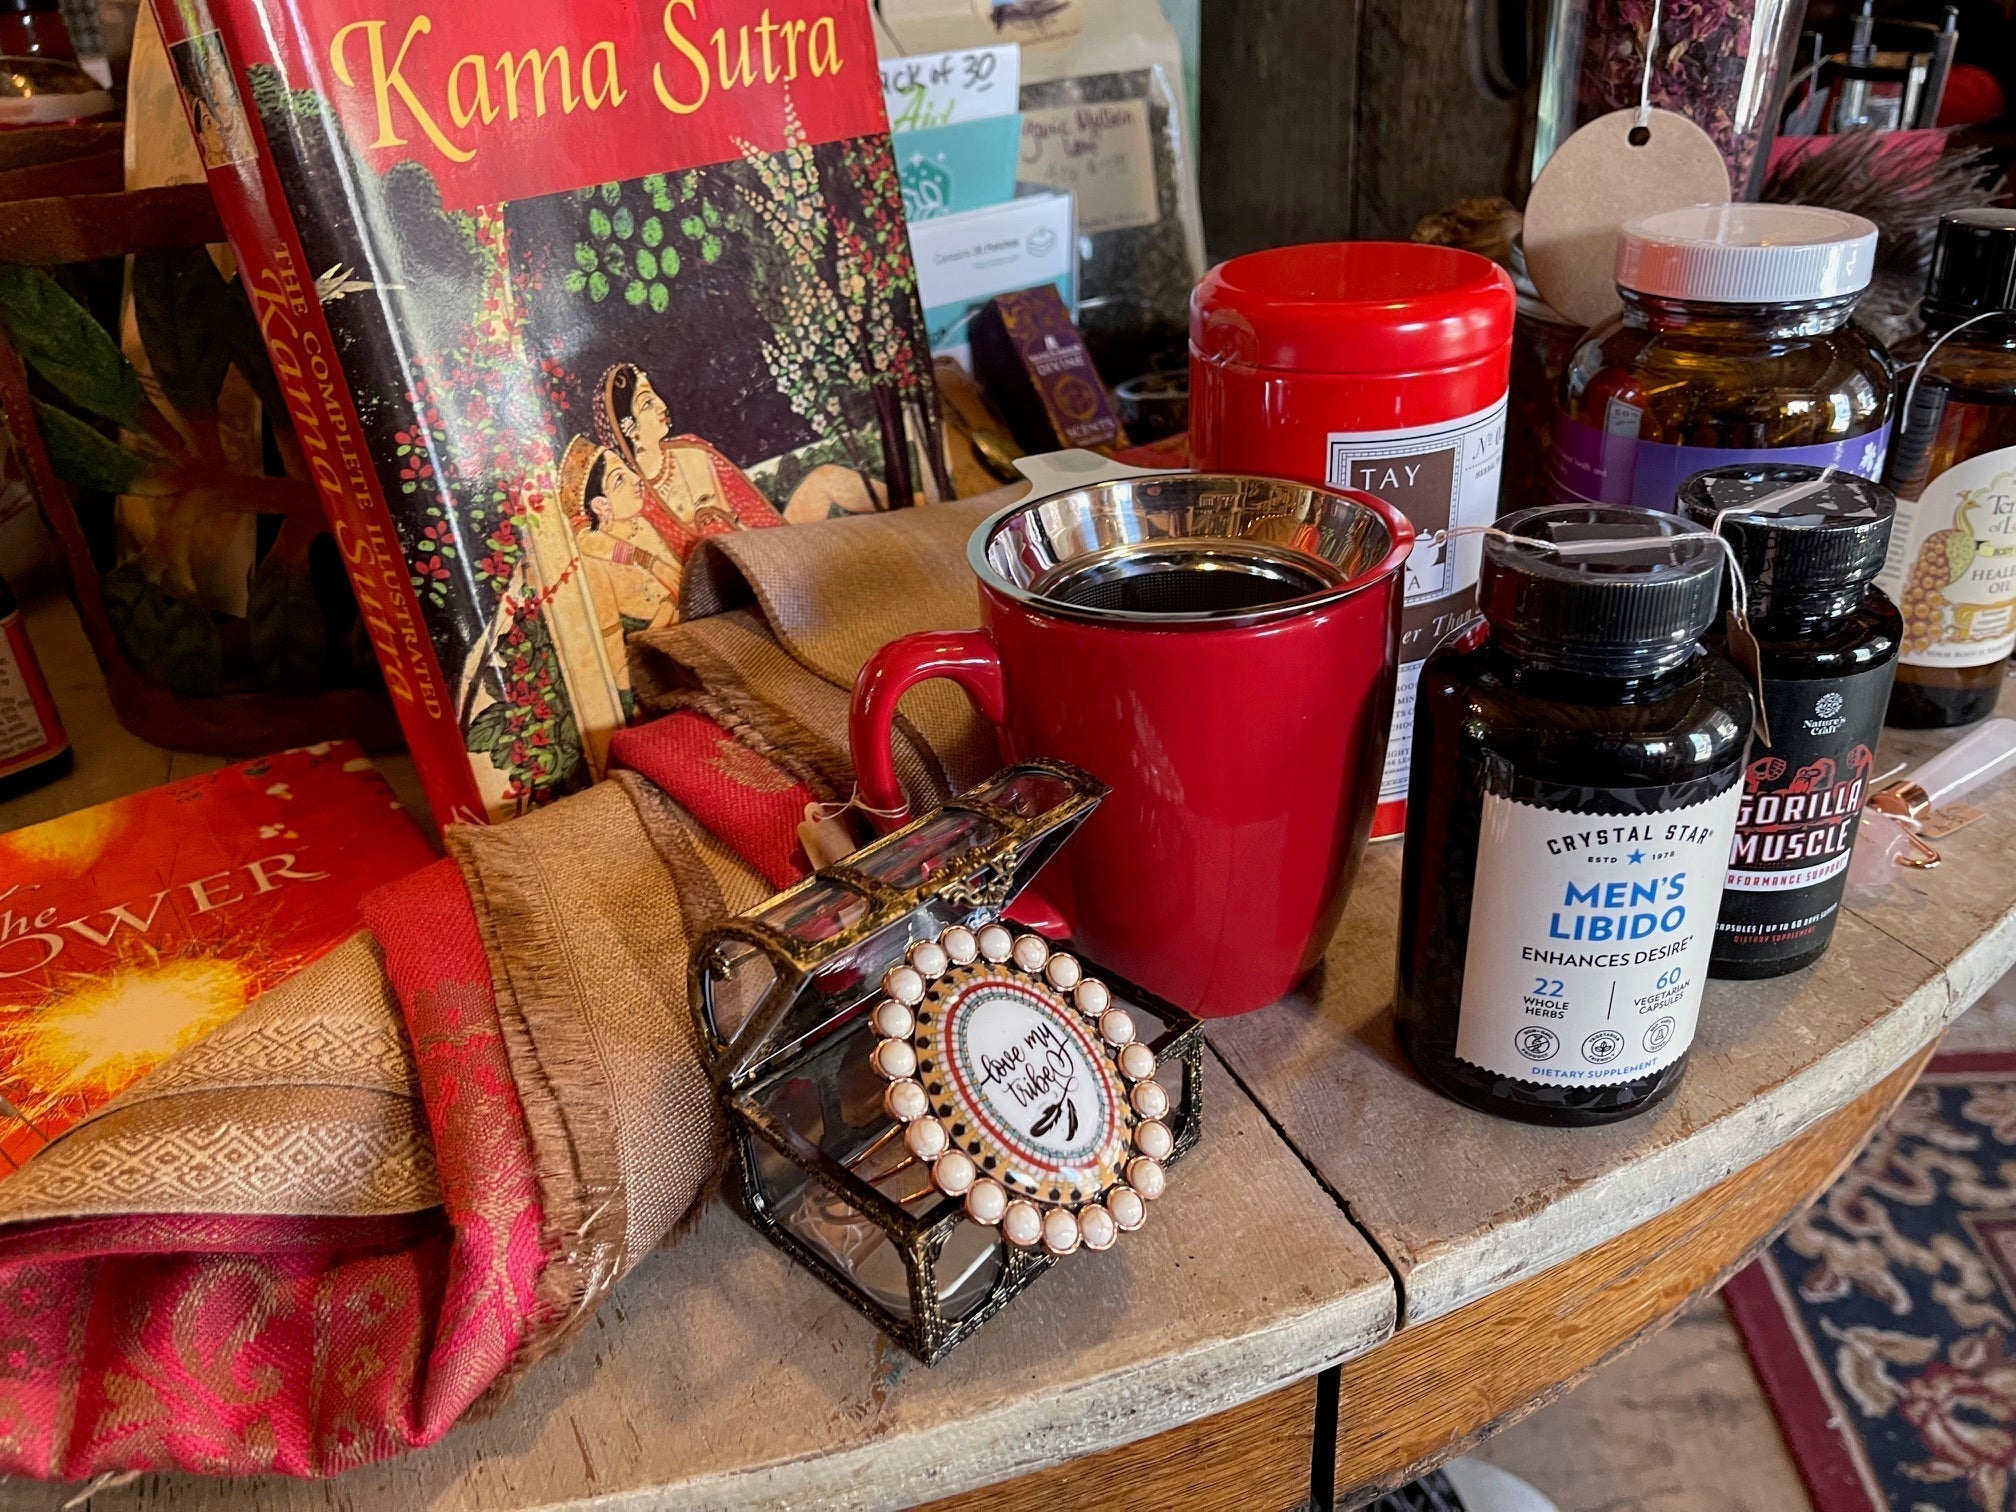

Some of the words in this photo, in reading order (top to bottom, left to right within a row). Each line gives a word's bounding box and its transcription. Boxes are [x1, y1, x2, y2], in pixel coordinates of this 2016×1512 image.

[330, 14, 627, 164] Kama
[653, 0, 844, 115] Sutra
[880, 63, 926, 94] ack
[930, 56, 953, 85] of
[962, 53, 997, 91] 30
[252, 268, 344, 496] Kama
[336, 520, 414, 704] Sutra
[273, 242, 308, 316] THE
[302, 331, 374, 510] COMPLETE
[366, 524, 442, 720] ILLUSTRATED
[1359, 463, 1421, 491] TAY
[1802, 715, 1847, 729] Nature's
[1810, 726, 1838, 736] Craft
[1736, 778, 1863, 826] GORILLA
[1546, 825, 1654, 856] CRYSTAL
[1729, 818, 1851, 866] MUSCLE
[1587, 856, 1618, 864] ESTD
[1563, 872, 1687, 909] MEN'S
[1727, 873, 1802, 887] RFORMANCE
[0, 853, 331, 979] OWER
[0, 905, 57, 942] he
[1548, 905, 1687, 942] LIBIDO
[1765, 925, 1777, 934] UP
[1779, 922, 1790, 932] TO
[1791, 919, 1803, 930] 60
[1521, 946, 1630, 968] ENHANCES
[1532, 977, 1565, 998] 22
[1633, 978, 1691, 1007] VEGETARIAN
[1656, 966, 1682, 990] 60
[1523, 995, 1570, 1011] WHOLE
[1525, 1006, 1565, 1020] HERBS
[1638, 991, 1684, 1015] CAPSULES
[980, 1046, 1026, 1086] love
[1531, 1065, 1586, 1079] DIETARY
[1586, 1056, 1659, 1080] SUPPLEMENT
[1002, 1062, 1056, 1108] tribe
